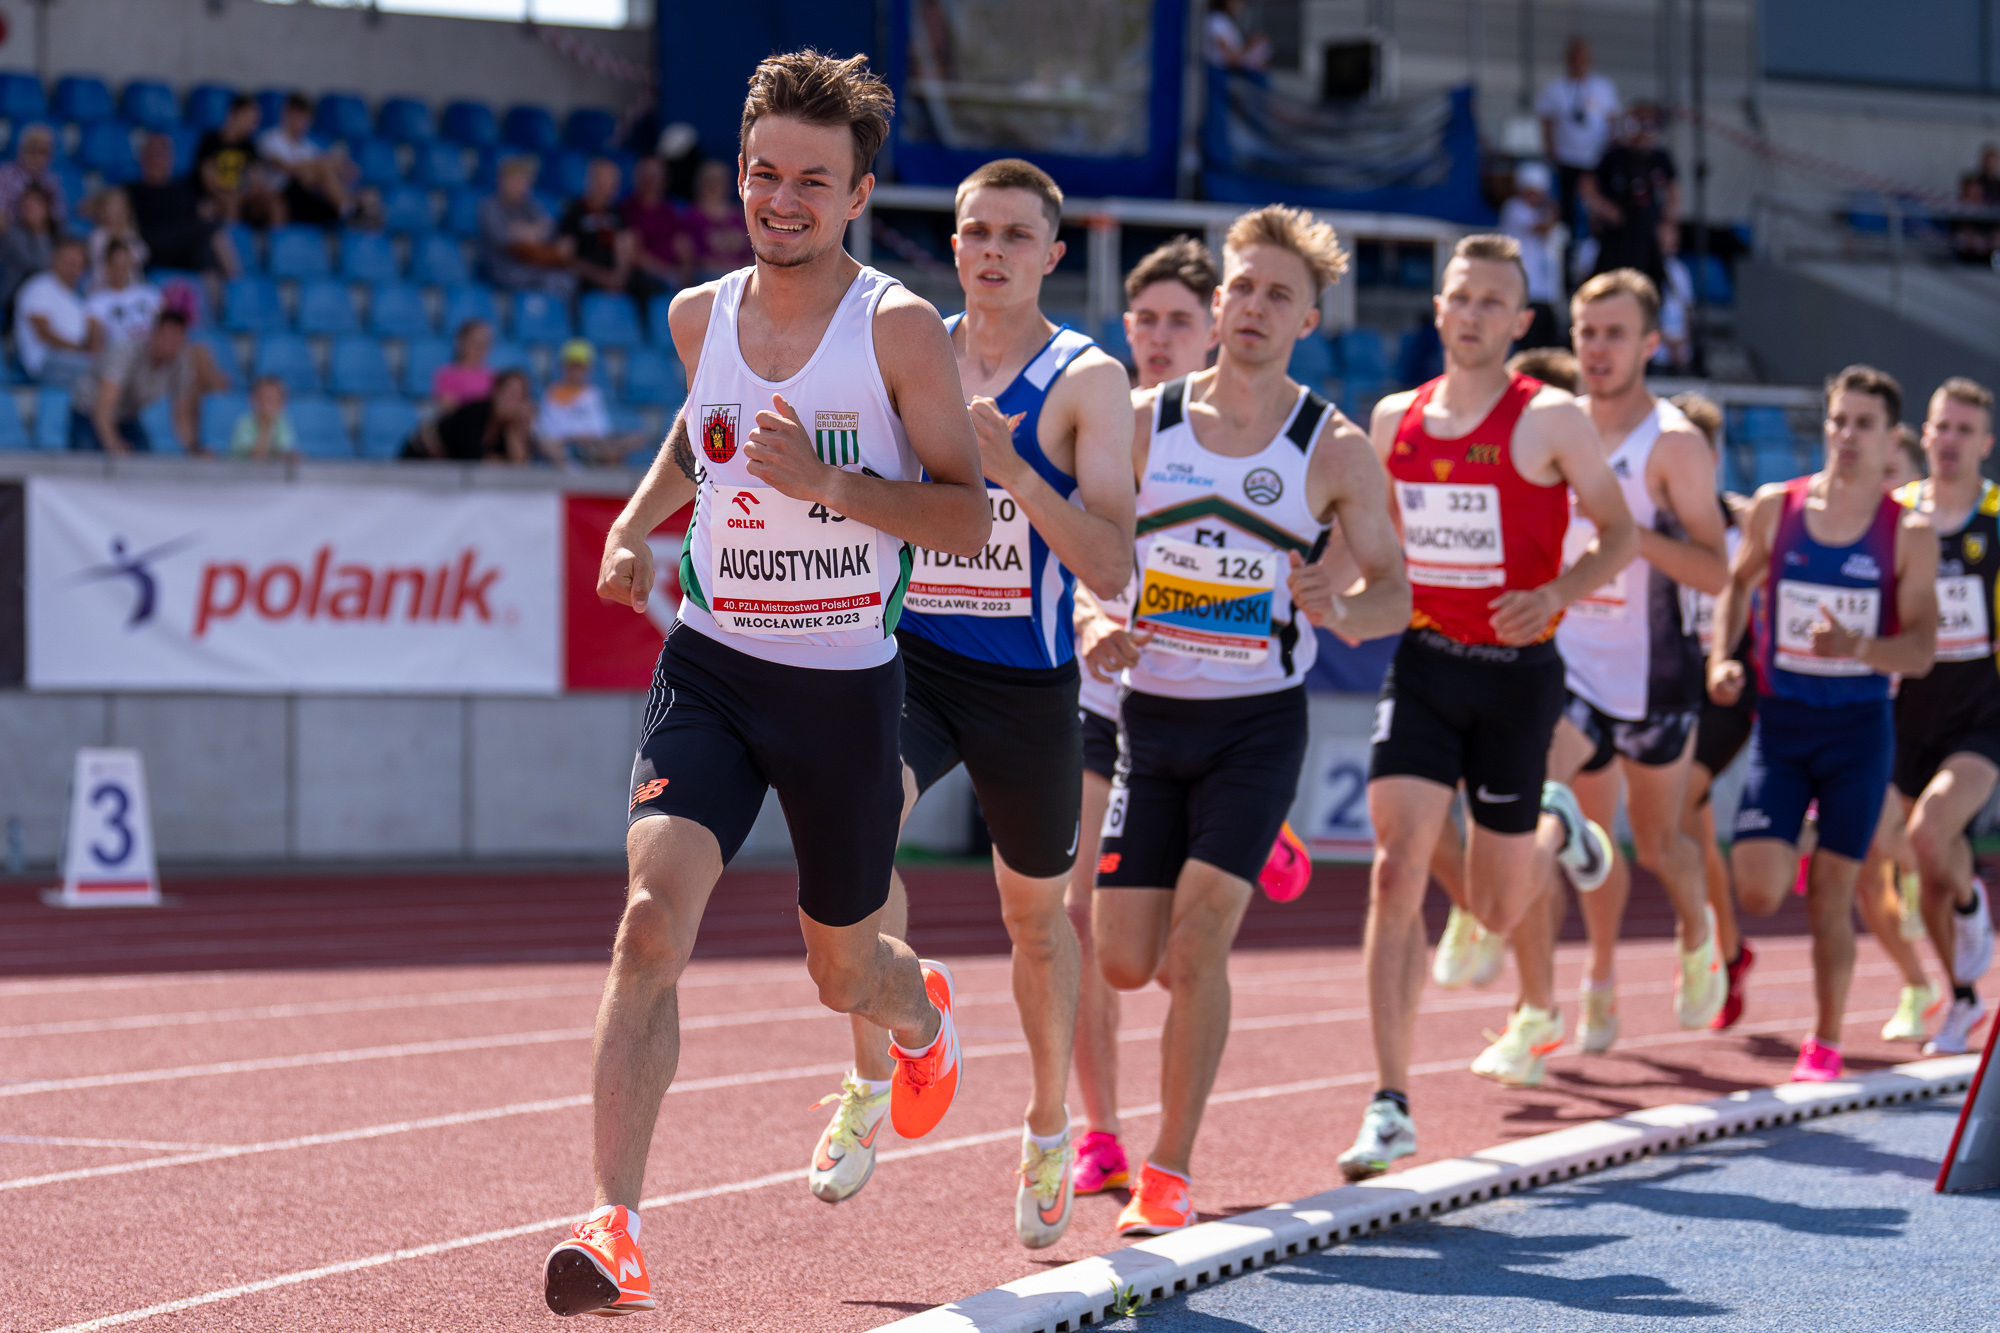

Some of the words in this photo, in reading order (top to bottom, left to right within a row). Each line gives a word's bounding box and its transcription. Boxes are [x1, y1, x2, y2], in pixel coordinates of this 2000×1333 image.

[1448, 491, 1487, 512] 323
[727, 518, 765, 530] ORLEN
[719, 543, 871, 582] AUGUSTYNIAK
[1217, 556, 1264, 580] 126
[188, 543, 503, 641] polanik
[909, 583, 926, 593] PZLA
[927, 585, 977, 597] Mistrzostwa
[978, 588, 1003, 598] Polski
[1004, 588, 1022, 598] U23
[723, 600, 737, 610] 40.
[738, 602, 760, 612] PZLA
[761, 602, 819, 613] Mistrzostwa
[821, 599, 850, 611] Polski
[852, 596, 871, 607] U23
[906, 595, 979, 611] WŁOCŁAWEK
[981, 601, 1011, 612] 2023
[1145, 583, 1269, 623] OSTROWSKI
[733, 614, 823, 630] WŁOCŁAWEK
[826, 612, 861, 627] 2023
[1326, 761, 1368, 827] 2
[87, 780, 135, 867] 3
[1111, 798, 1123, 828] 6
